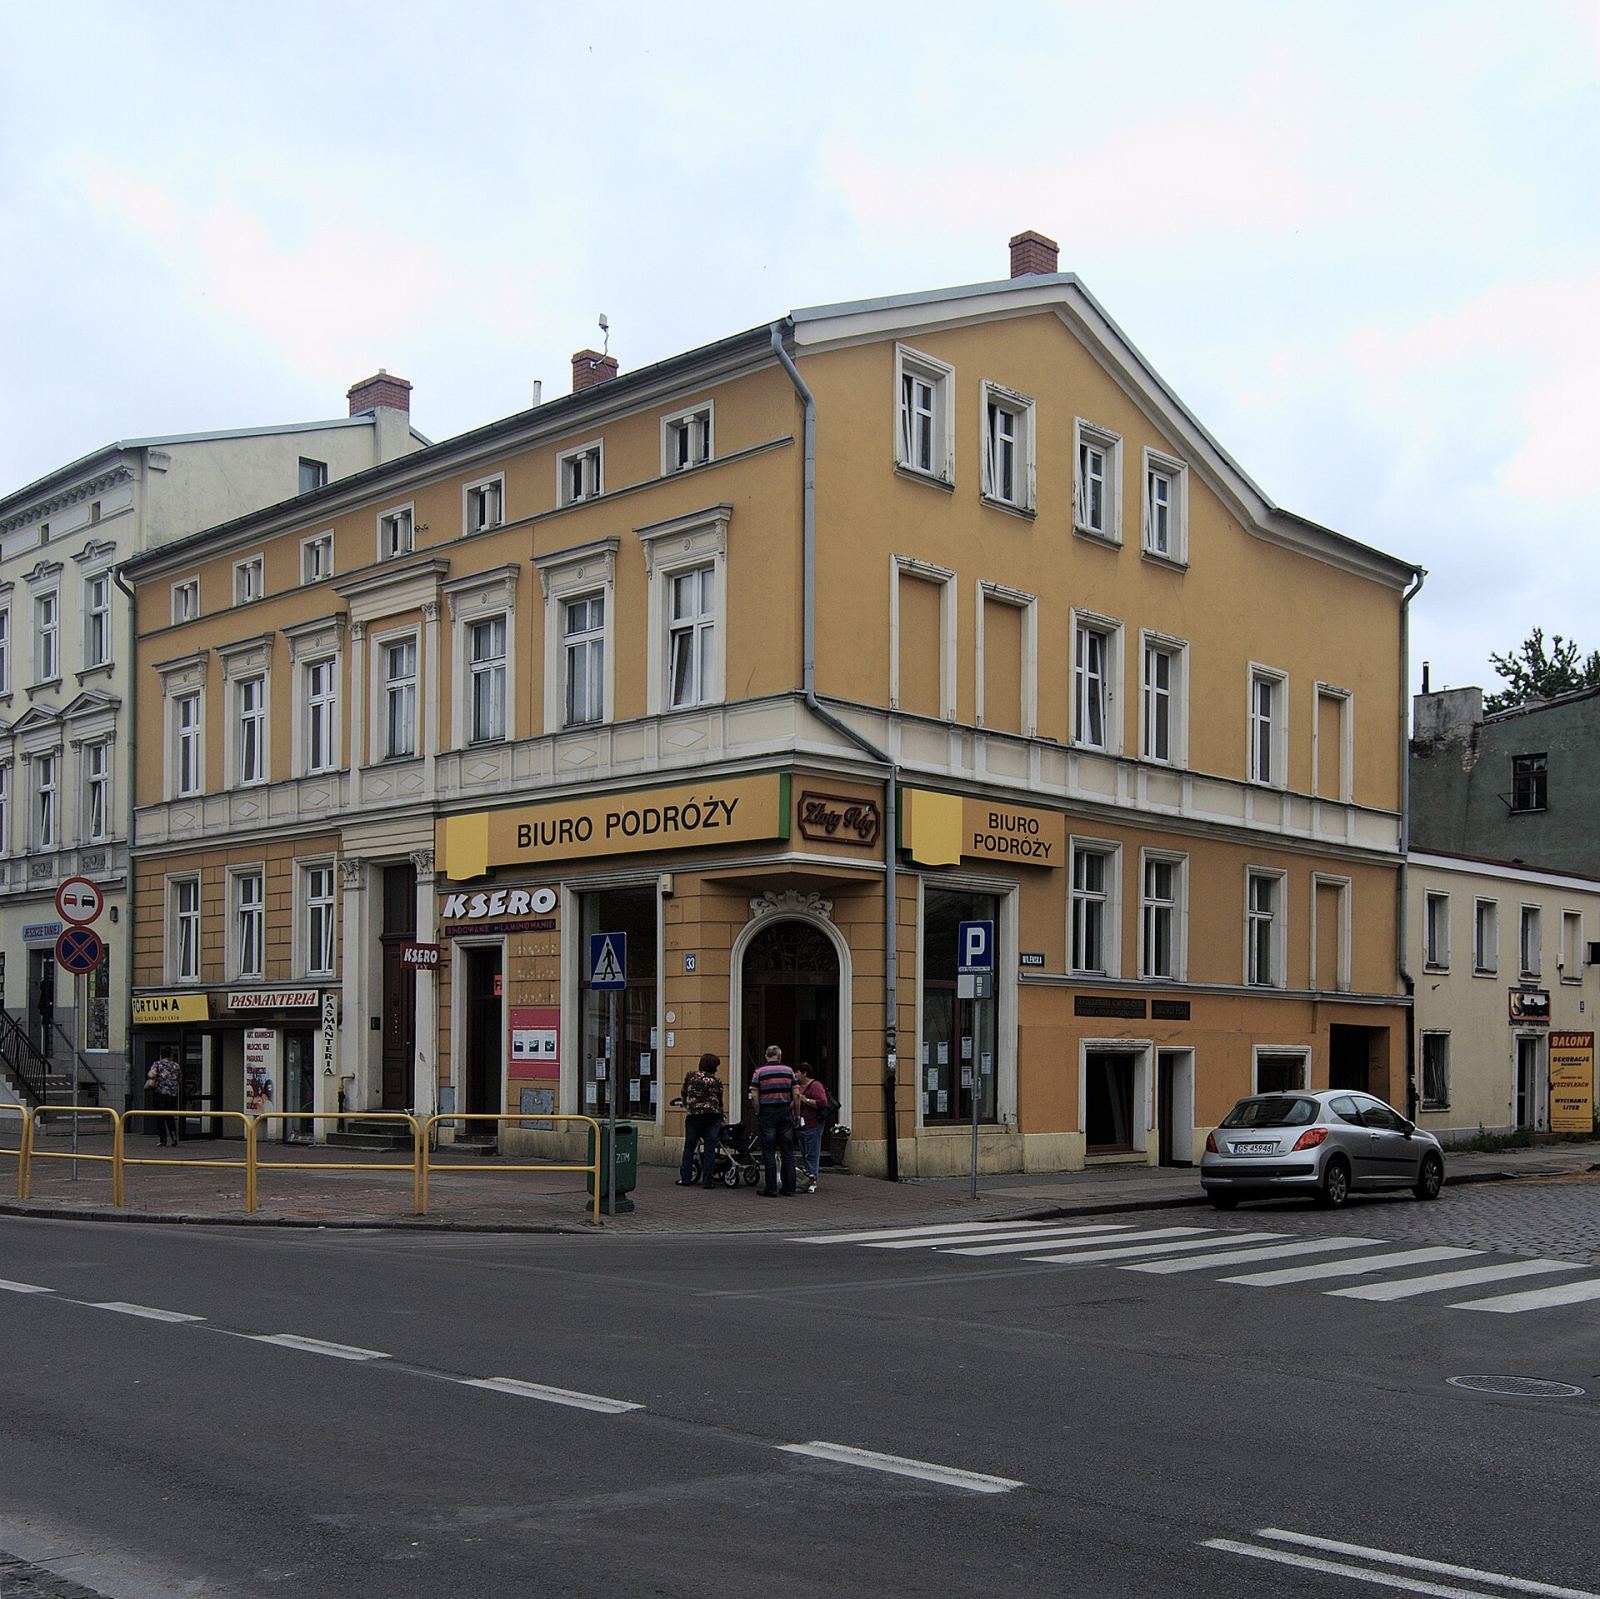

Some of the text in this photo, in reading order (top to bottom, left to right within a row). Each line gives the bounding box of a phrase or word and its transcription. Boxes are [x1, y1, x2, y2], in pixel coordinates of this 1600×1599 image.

[517, 795, 739, 848] BIURO PODRÓŻY
[803, 801, 843, 834] Złoty
[988, 812, 1039, 835] BIURO
[973, 833, 1052, 859] PODRÓŻY
[443, 888, 557, 919] KSERO
[403, 948, 438, 964] KSERO
[966, 927, 985, 966] P
[686, 957, 695, 970] 33
[133, 998, 180, 1013] FORTUNA
[230, 992, 316, 1007] PASMANTERIA
[323, 995, 336, 1075] PASMANTERIA
[1552, 1036, 1591, 1047] BALONY
